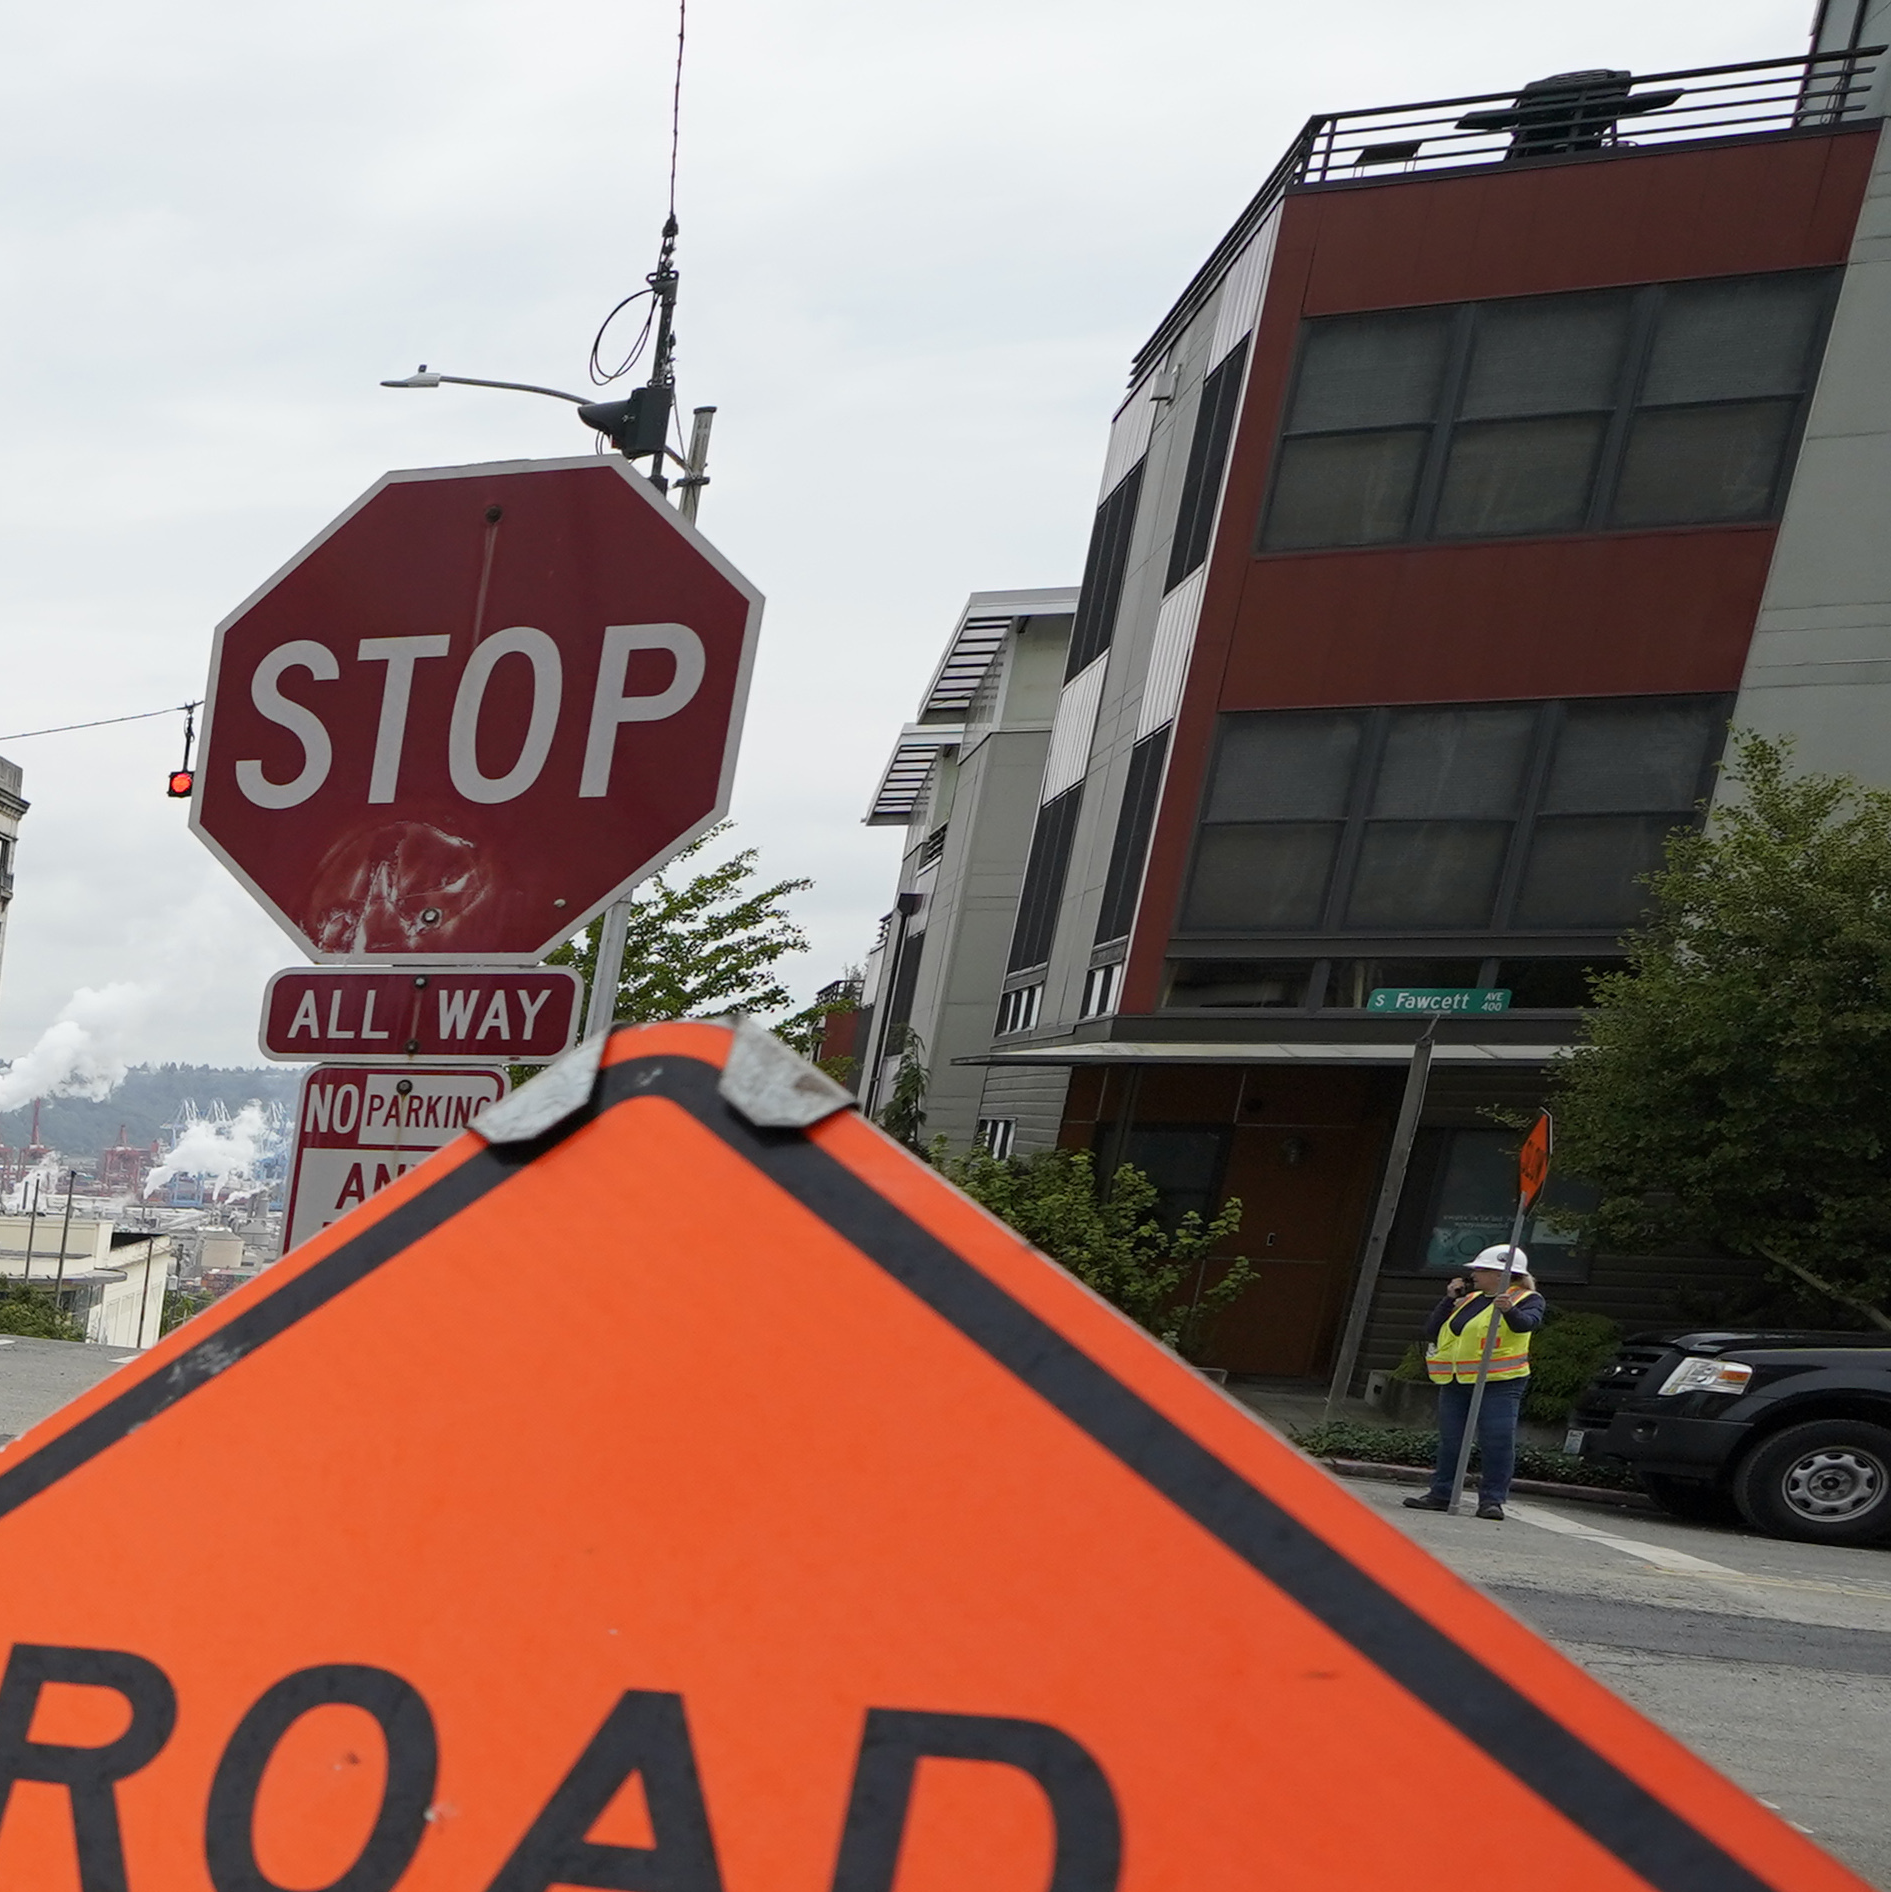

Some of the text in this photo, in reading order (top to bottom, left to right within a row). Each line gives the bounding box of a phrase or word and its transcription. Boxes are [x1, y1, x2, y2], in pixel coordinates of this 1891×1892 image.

[235, 622, 707, 810] STOP
[1375, 992, 1470, 1010] S Fawcett
[1481, 1002, 1502, 1012] 400
[1484, 992, 1504, 1001] AVE
[287, 989, 552, 1041] ALL WAY
[304, 1083, 360, 1135] NO
